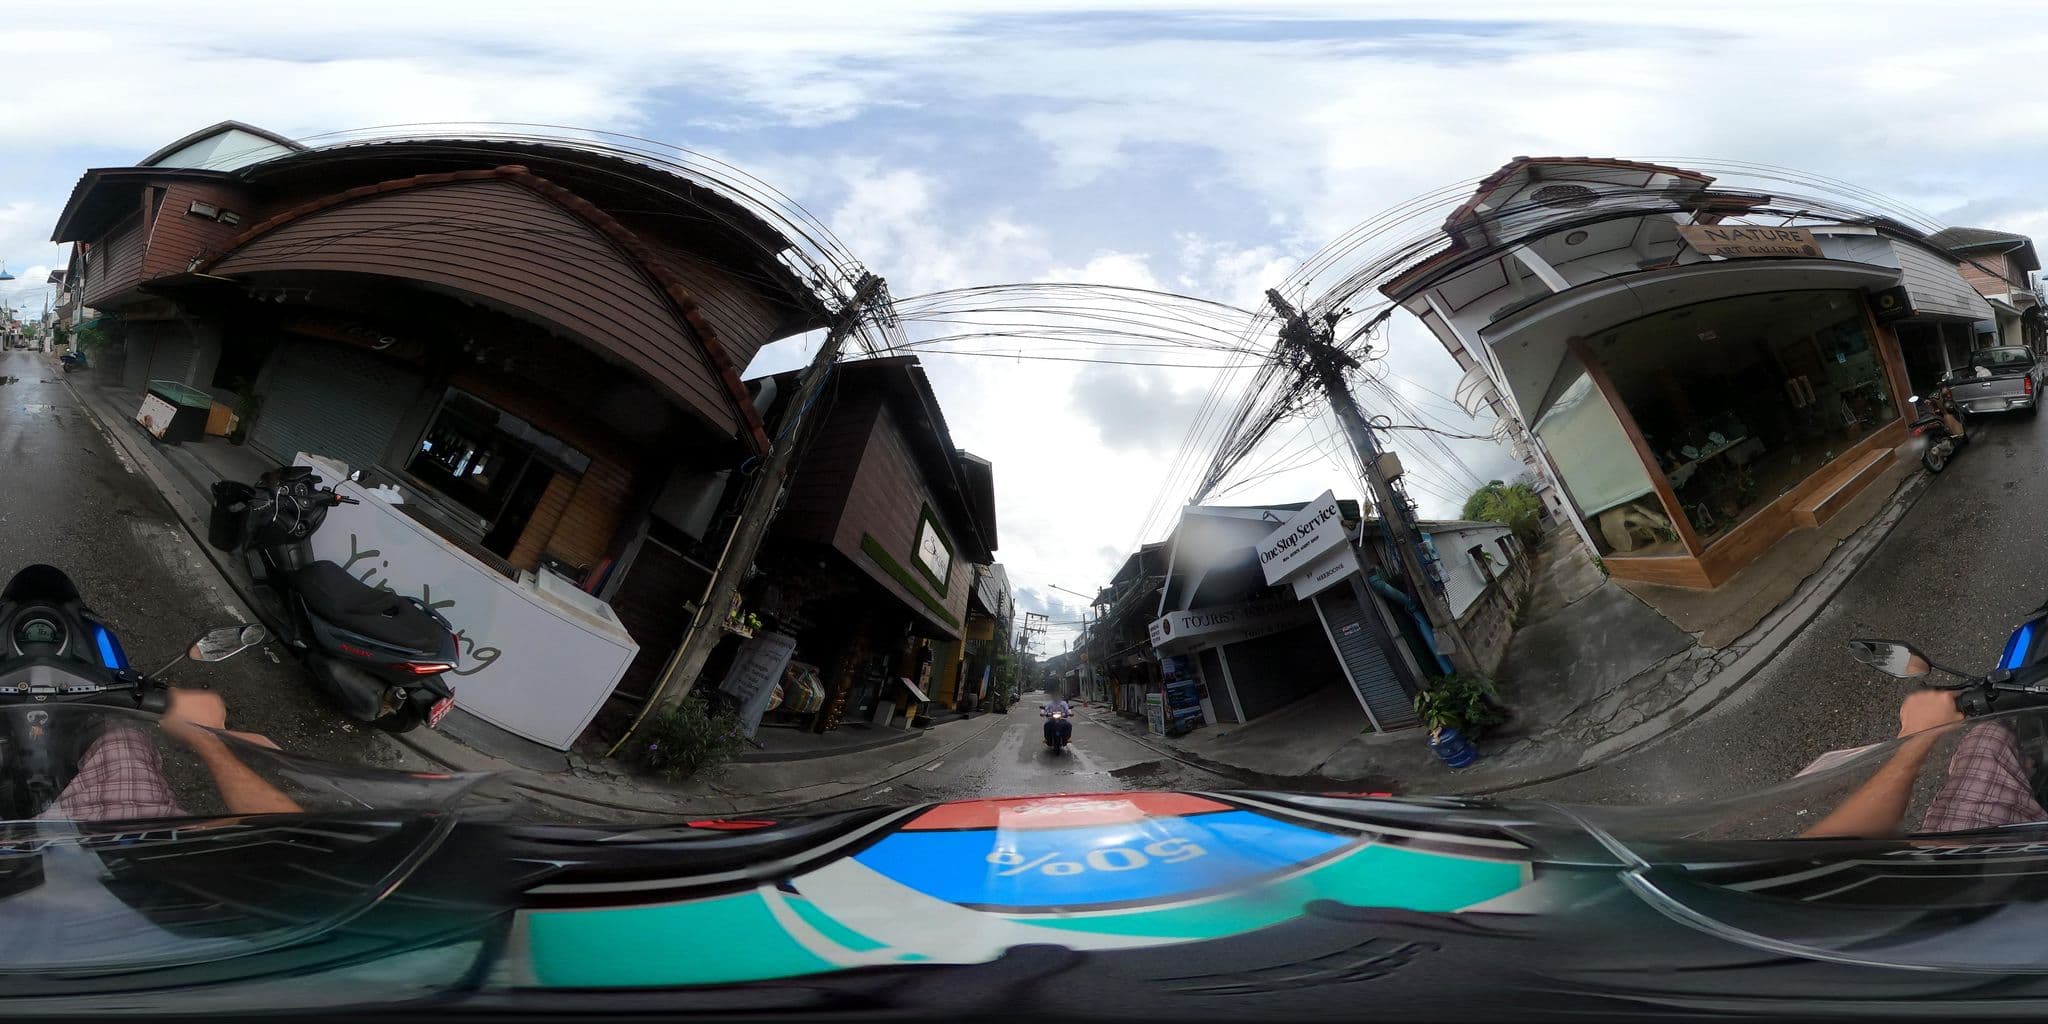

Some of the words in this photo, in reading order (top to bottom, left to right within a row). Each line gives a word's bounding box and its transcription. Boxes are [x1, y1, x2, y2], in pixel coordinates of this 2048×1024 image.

[1704, 228, 1804, 242] NATURE
[1713, 245, 1742, 256] ART
[1748, 244, 1800, 255] GALLERY
[1260, 546, 1280, 564] One
[1276, 532, 1299, 554] Stop
[1296, 504, 1337, 539] Service
[1182, 613, 1236, 629] TOURIST
[985, 837, 1208, 877] 50%
